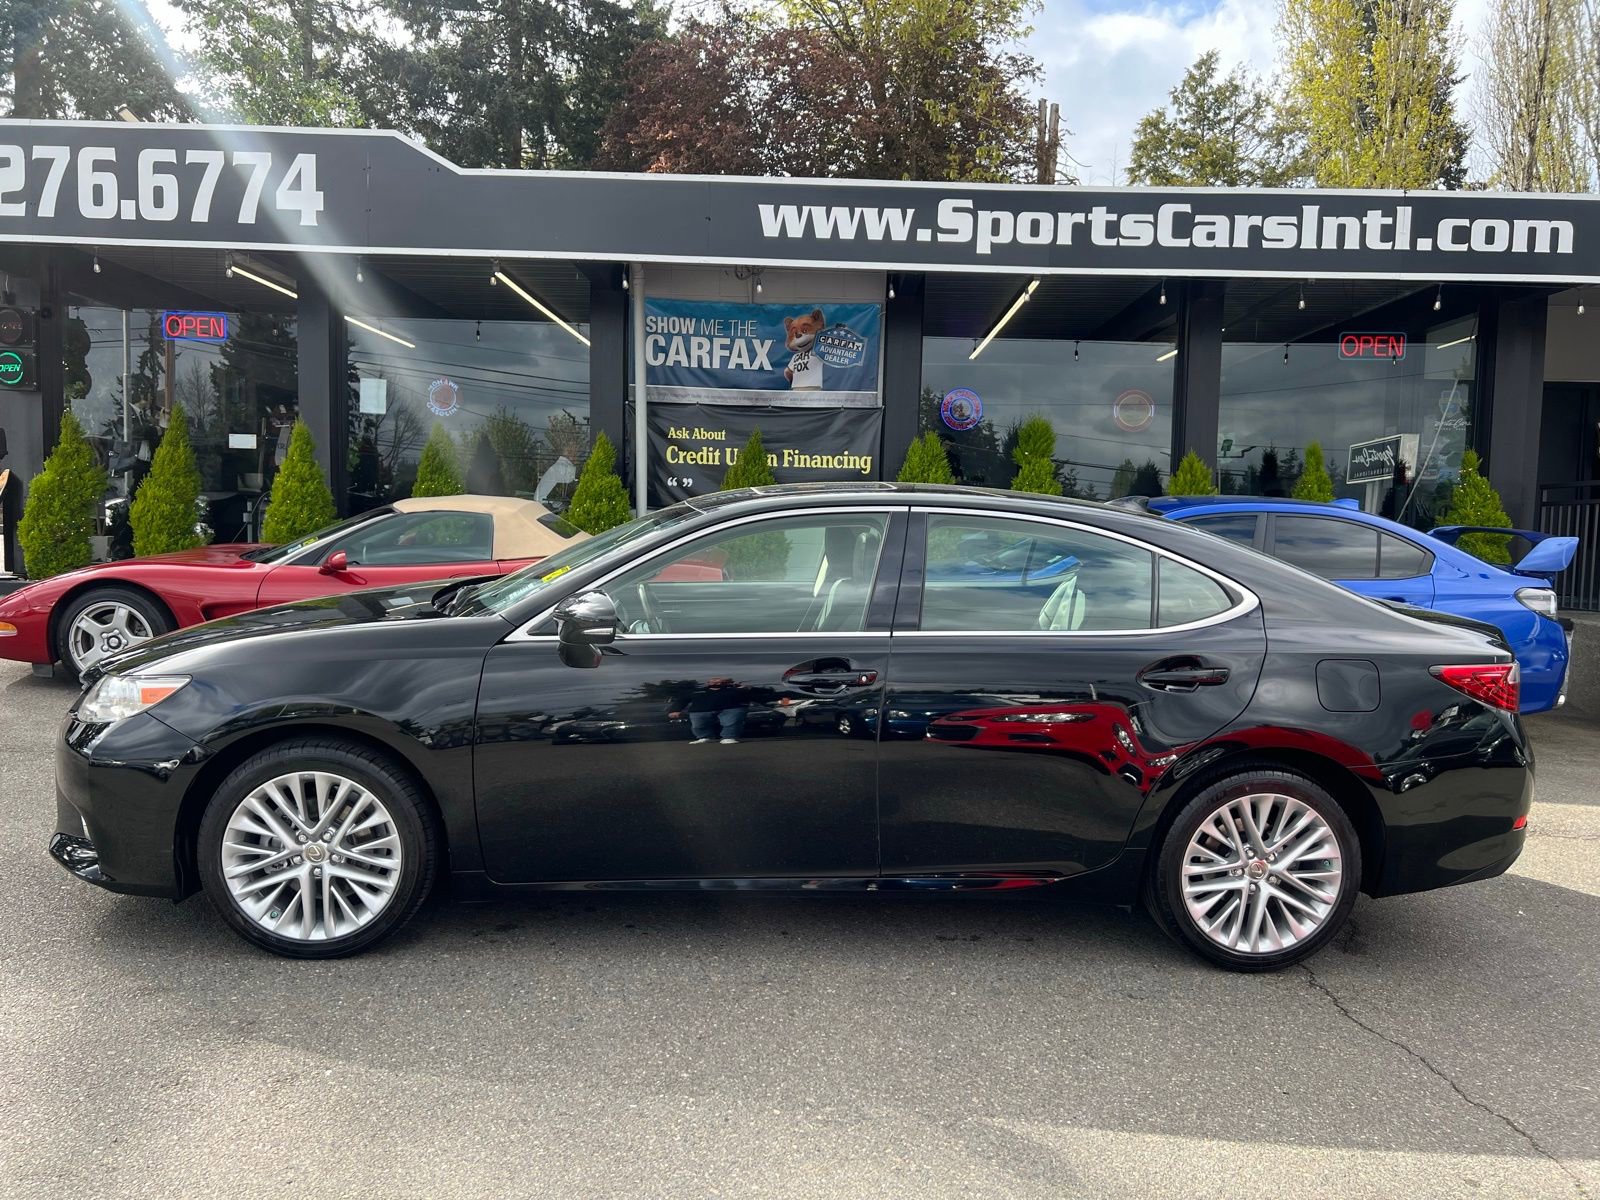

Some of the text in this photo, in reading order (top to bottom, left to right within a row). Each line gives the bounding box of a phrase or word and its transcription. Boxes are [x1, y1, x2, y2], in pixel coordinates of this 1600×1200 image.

[758, 198, 1573, 254] www.SportsCarsIntl.com
[166, 315, 224, 337] OPEN
[645, 315, 758, 338] SHOW ME THE
[645, 333, 774, 371] CARFAX
[820, 336, 863, 351] CARFAX
[820, 345, 857, 359] ADVANTAGE
[1341, 335, 1404, 357] OPEN
[793, 361, 809, 372] FOX
[824, 354, 849, 365] DEALER
[668, 427, 726, 441] Ask About
[666, 446, 720, 466] Credit
[782, 449, 873, 474] Financing
